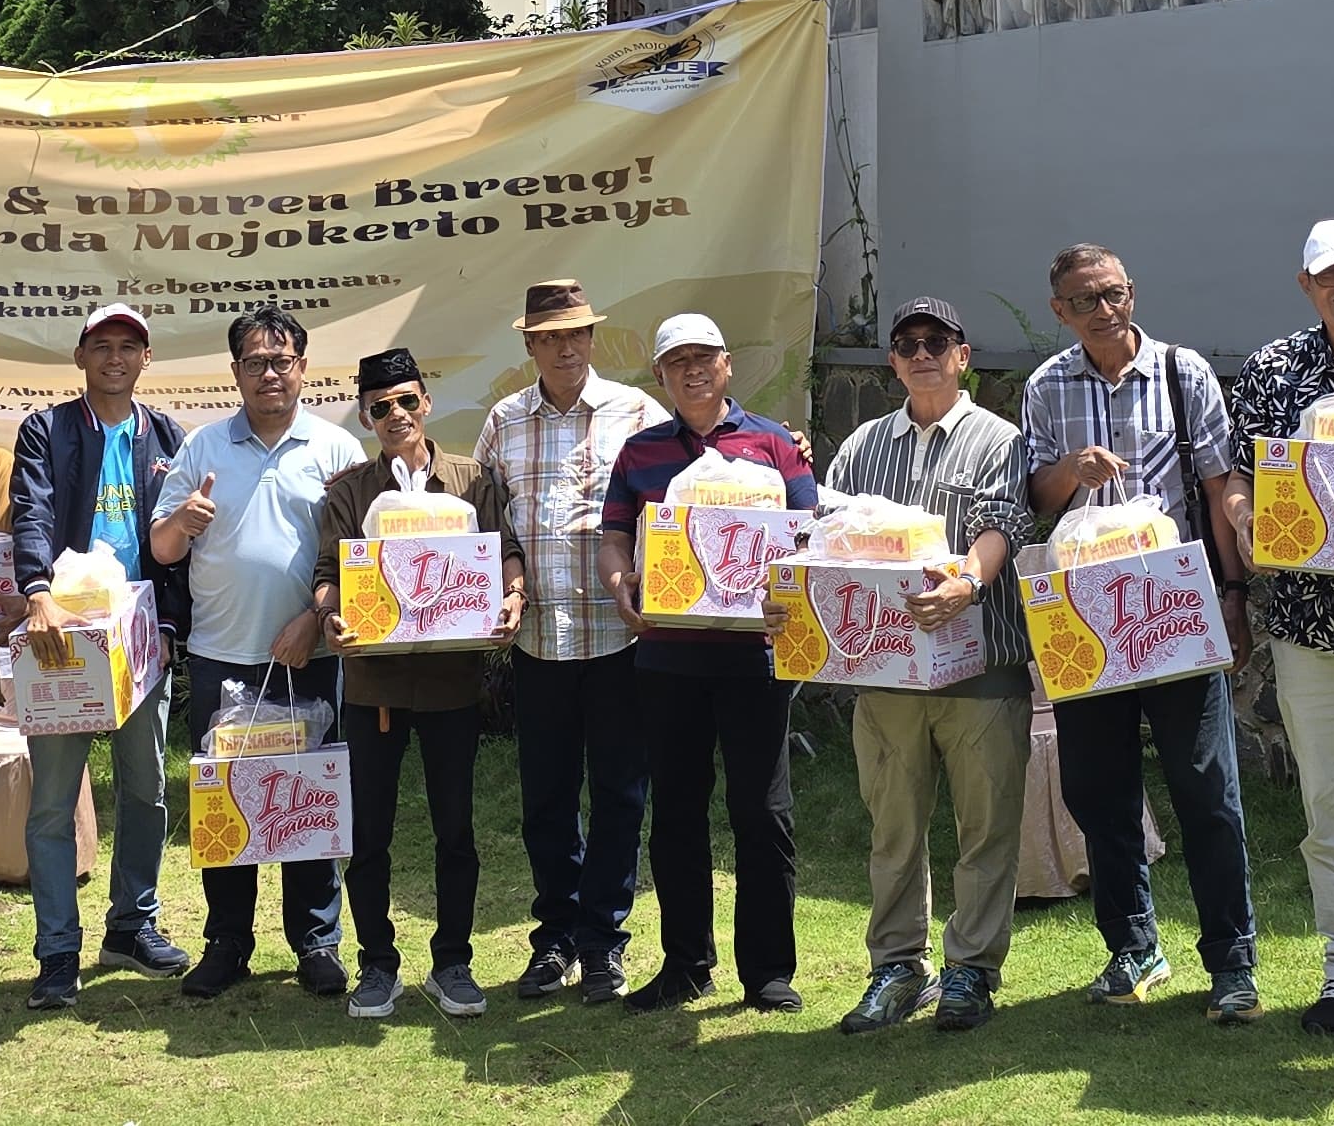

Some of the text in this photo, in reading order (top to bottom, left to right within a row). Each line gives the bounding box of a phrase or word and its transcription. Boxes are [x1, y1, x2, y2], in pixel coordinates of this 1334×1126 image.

[3, 186, 51, 216] &
[75, 186, 350, 216] nDuren
[374, 155, 655, 208] Bareng!
[133, 210, 500, 259] Mojokerto
[523, 195, 692, 230] Raya
[117, 273, 402, 296] Kebersamaan,
[382, 518, 409, 533] TAPE
[715, 521, 748, 574] I
[409, 550, 491, 600] I Love
[410, 590, 490, 634] Trawas
[835, 582, 863, 638] I
[864, 590, 916, 634] Love
[1104, 572, 1204, 638] I Love
[840, 630, 916, 675] Trawas
[1117, 612, 1210, 672] Trawas
[256, 770, 339, 823] I Love
[260, 810, 339, 857] Trawas
